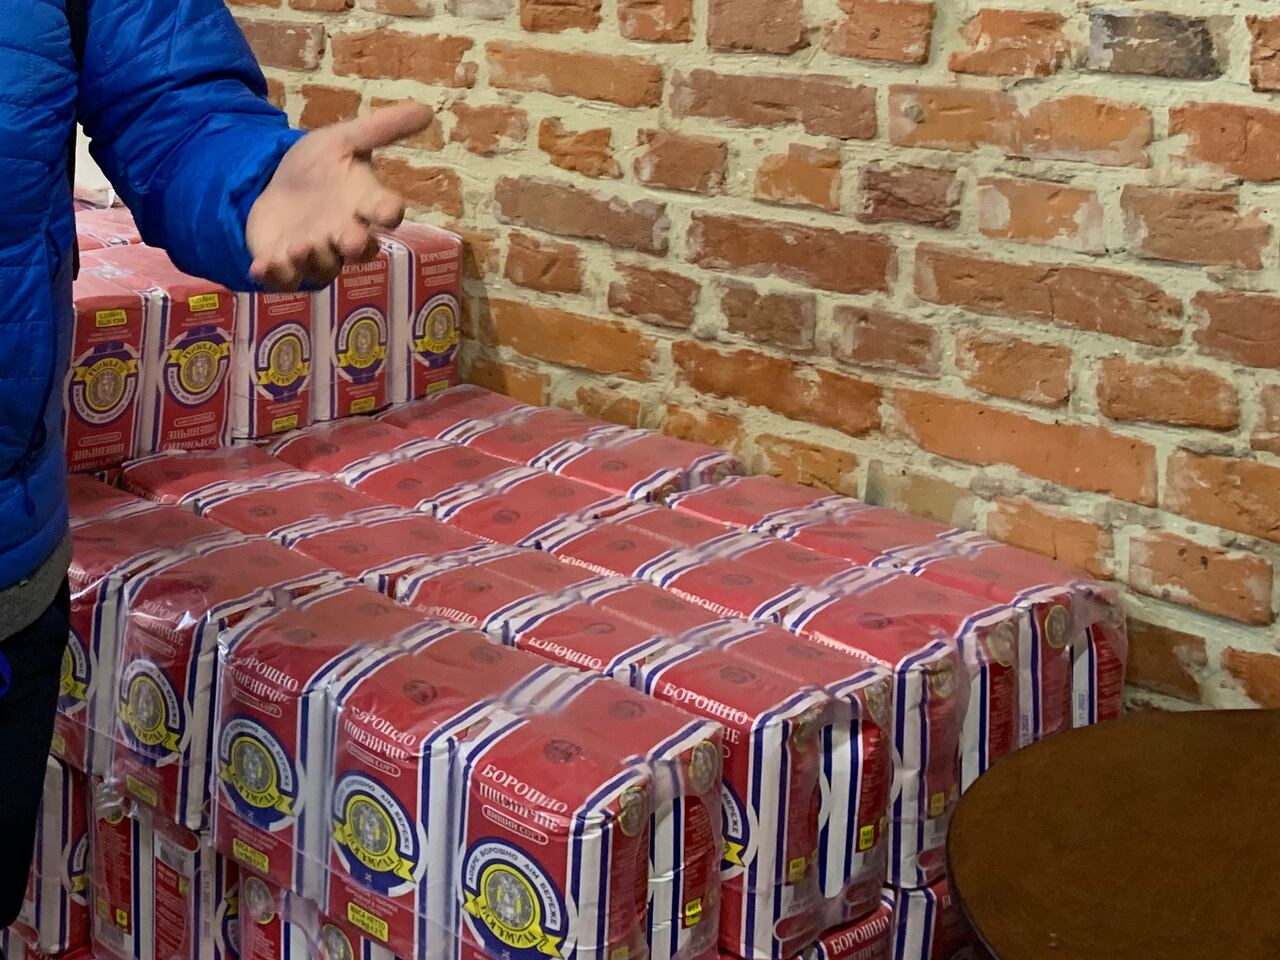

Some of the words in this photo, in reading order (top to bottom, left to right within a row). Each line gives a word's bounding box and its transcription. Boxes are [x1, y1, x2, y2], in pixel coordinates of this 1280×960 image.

[528, 637, 603, 669] БОРОШНО
[662, 682, 749, 725] БОРОШНО
[481, 764, 569, 813] БОРОШНО
[830, 916, 889, 955] БОРОШНО
